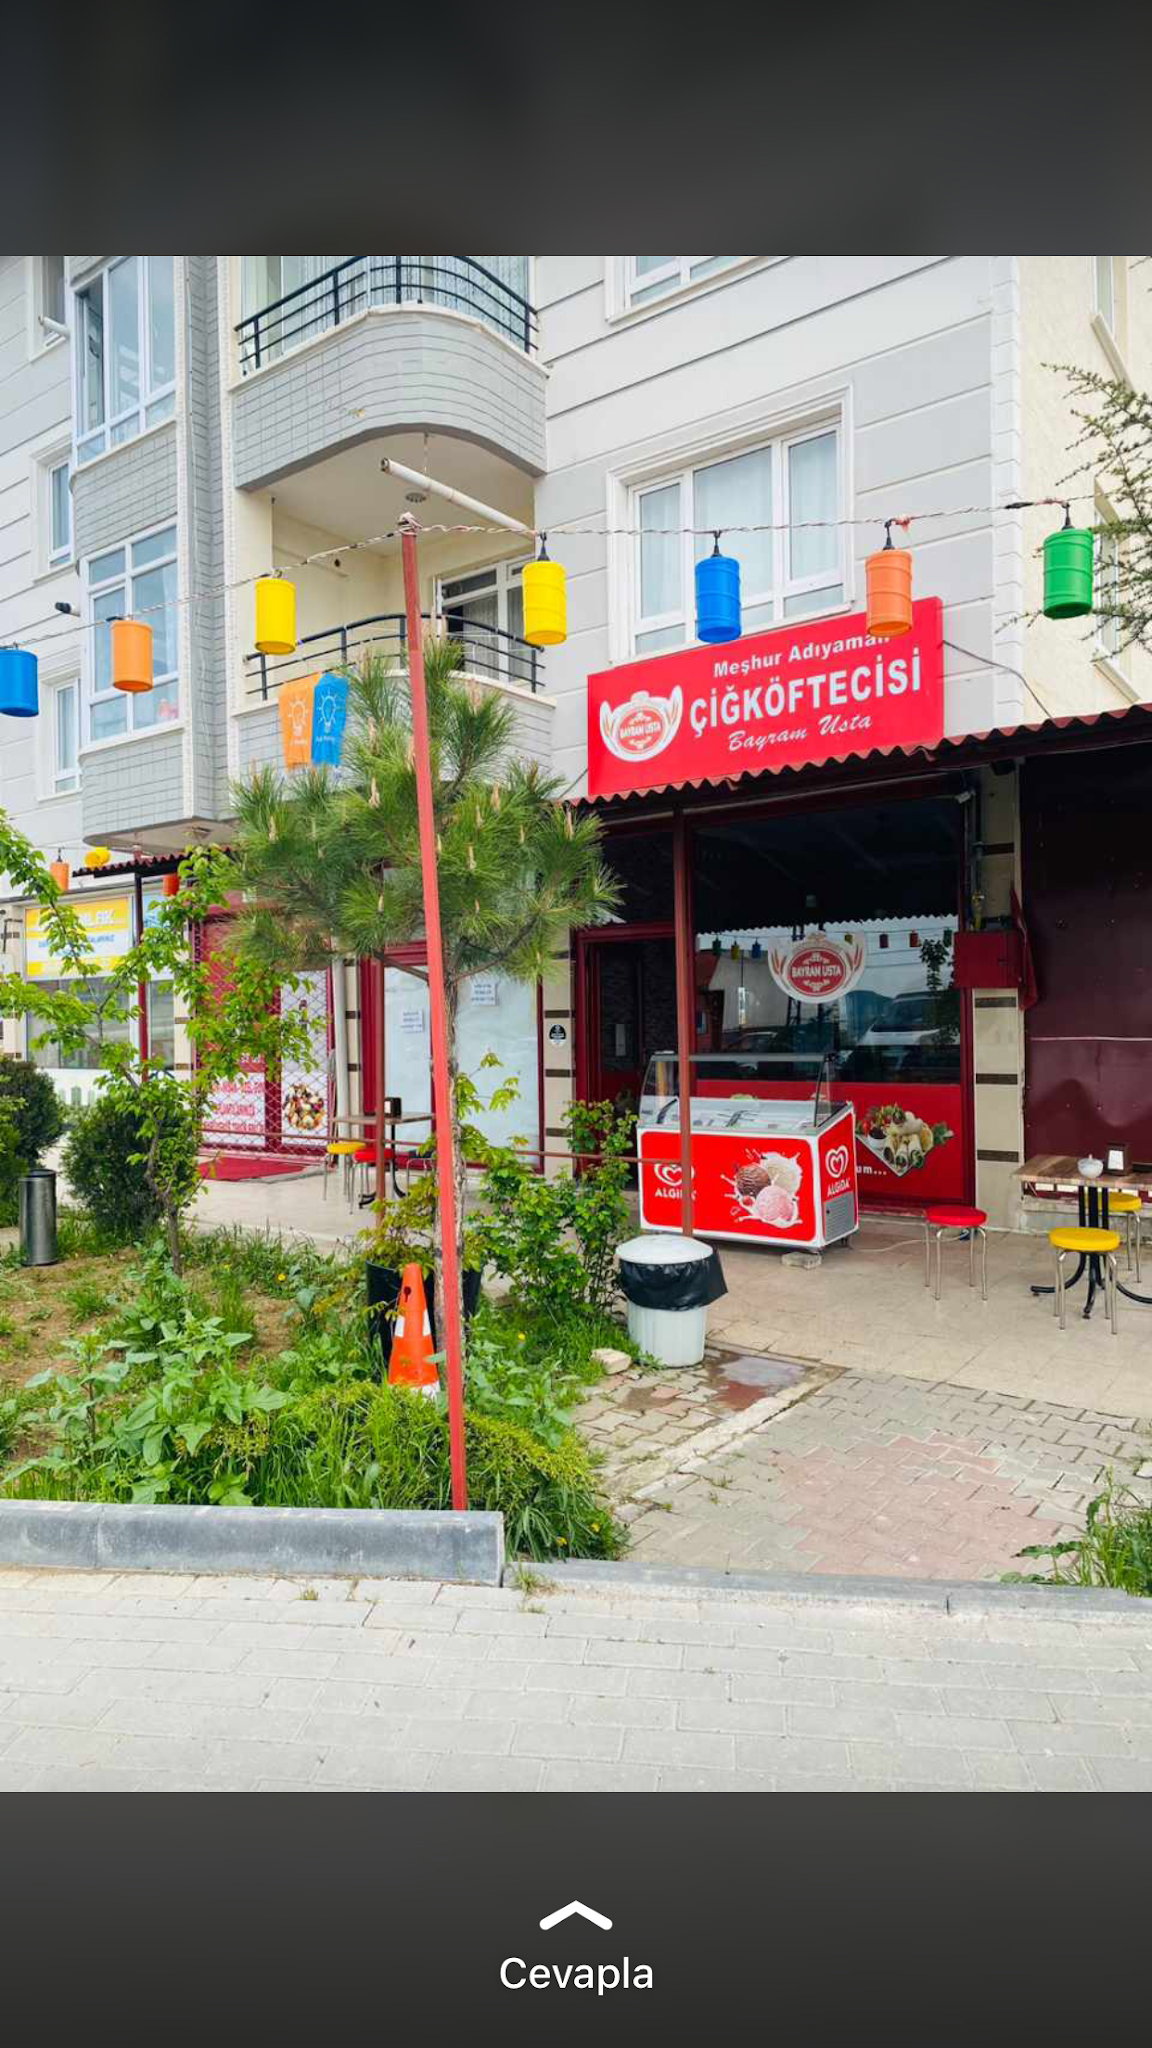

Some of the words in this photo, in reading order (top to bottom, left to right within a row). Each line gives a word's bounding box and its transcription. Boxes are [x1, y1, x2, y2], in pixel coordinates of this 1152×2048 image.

[713, 653, 782, 678] Meşhur
[690, 648, 920, 738] ÇİĞKÖFTECİSİ
[728, 727, 807, 751] Bayram
[818, 714, 873, 736] Usta
[792, 965, 820, 978] BAYRAM
[822, 964, 841, 977] USTA
